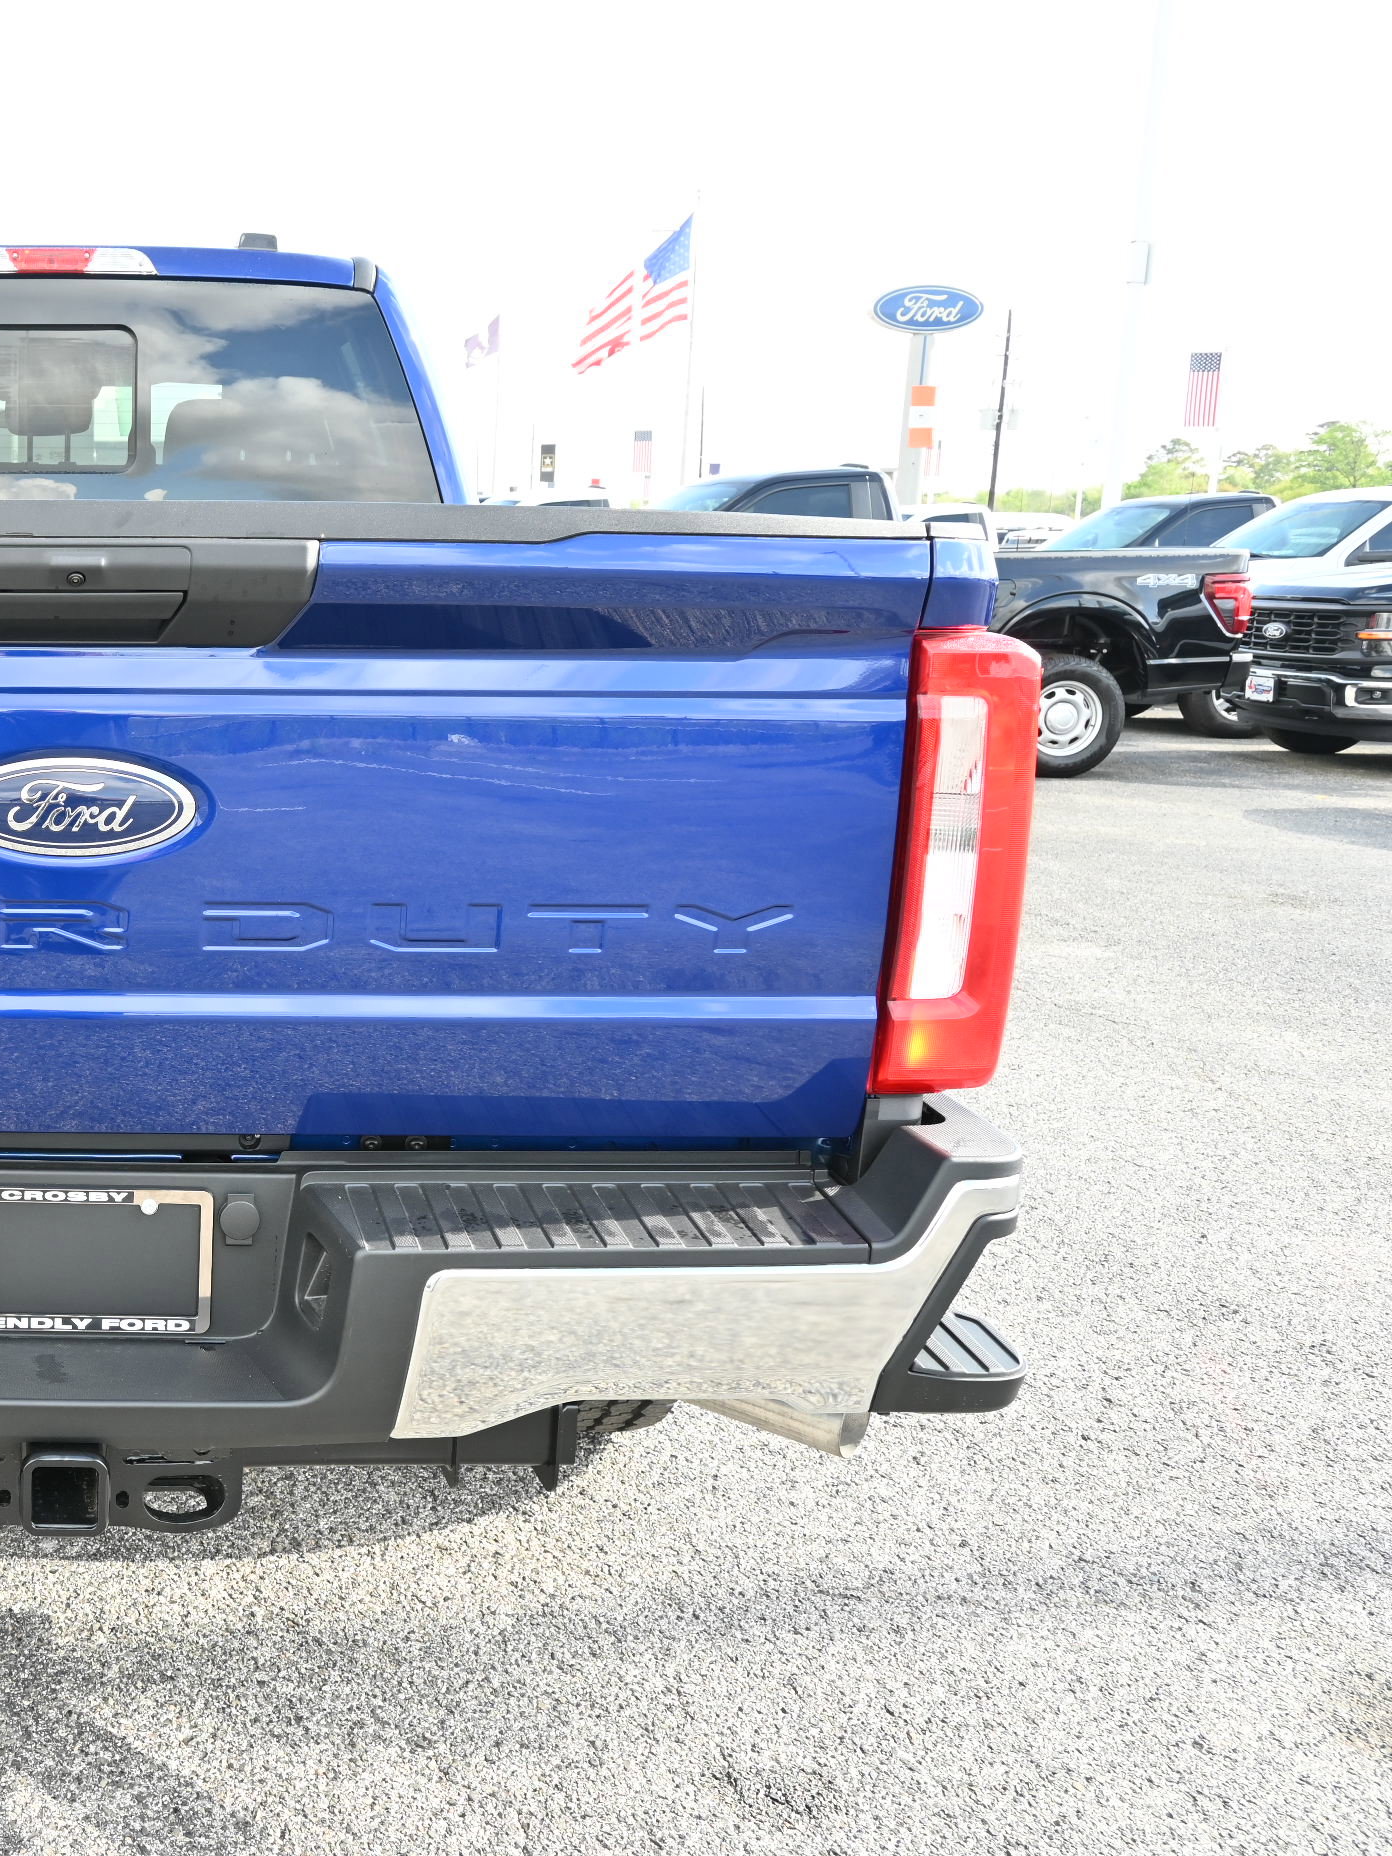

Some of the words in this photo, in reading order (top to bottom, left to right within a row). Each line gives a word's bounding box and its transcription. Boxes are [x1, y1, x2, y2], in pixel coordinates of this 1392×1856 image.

[896, 293, 964, 322] Ford
[7, 779, 137, 832] Ford
[202, 901, 794, 954] DUTY
[0, 1190, 129, 1203] CROSBY
[101, 1318, 190, 1332] FORD
